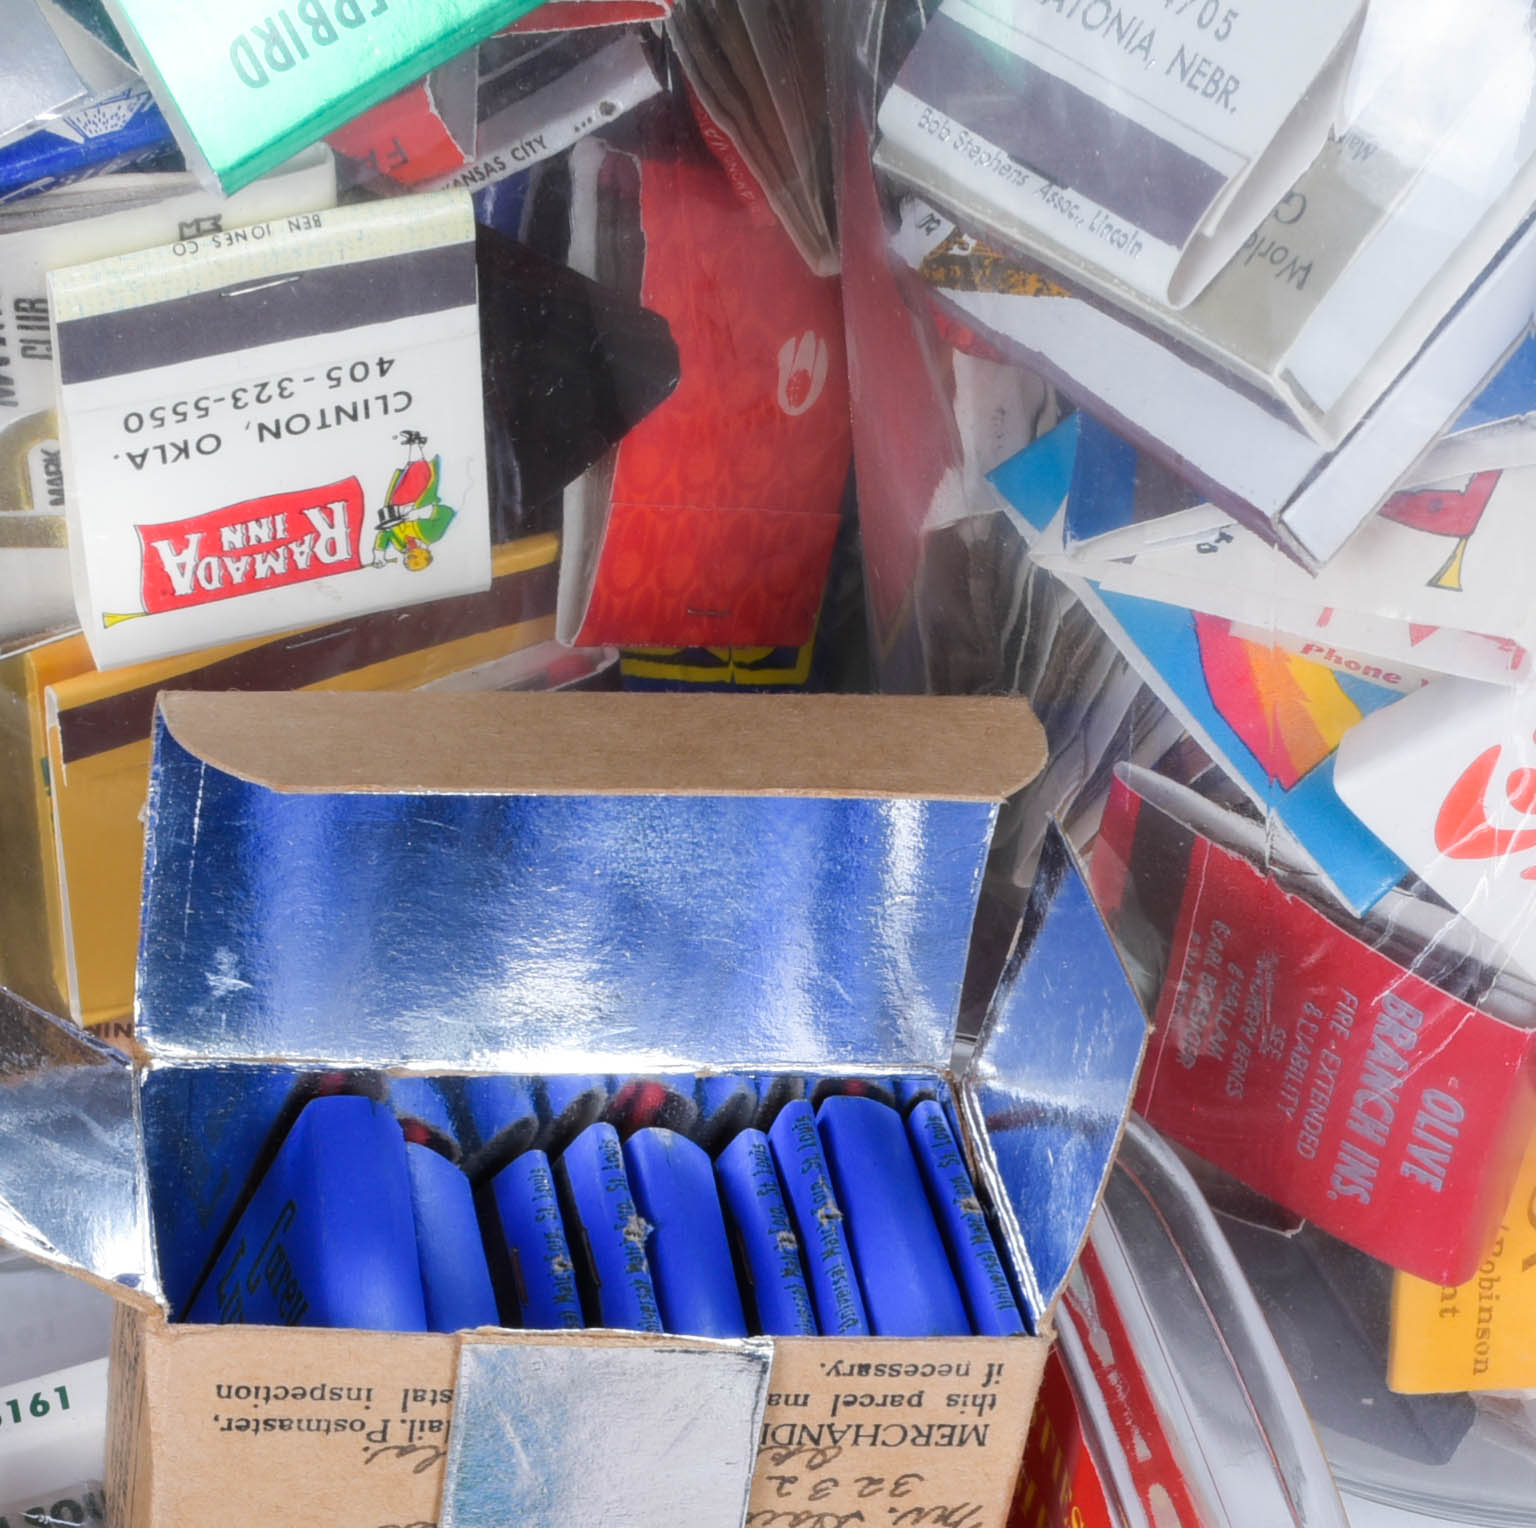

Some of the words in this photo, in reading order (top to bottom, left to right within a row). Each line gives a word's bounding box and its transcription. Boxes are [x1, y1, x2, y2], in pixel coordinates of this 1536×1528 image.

[1165, 43, 1241, 115] NEBR.
[511, 135, 549, 163] CITY
[917, 109, 952, 142] Bob
[953, 131, 1030, 188] Stephens
[1087, 209, 1145, 260] Lincoln
[289, 213, 323, 232] BEN
[244, 390, 413, 443] CLINTON,
[113, 432, 222, 470] OKLA.
[151, 500, 353, 596] RAMADA
[220, 512, 289, 551] INN
[1301, 642, 1403, 686] Phone
[1329, 988, 1359, 1040] FIRE
[1277, 1016, 1319, 1120] LIABILITY
[1346, 993, 1425, 1147] BRANCH
[792, 1114, 818, 1153] Louis
[925, 1115, 952, 1148] Louis
[1401, 1087, 1465, 1193] OLIVE
[1327, 1140, 1382, 1205] INS.
[820, 1360, 972, 1378] necessary.
[982, 1362, 1006, 1388] if
[215, 1383, 375, 1412] inspection
[831, 1393, 925, 1418] parcel
[946, 1393, 997, 1417] this
[212, 1413, 390, 1444] Postmaster,
[766, 1472, 925, 1502] 3232
